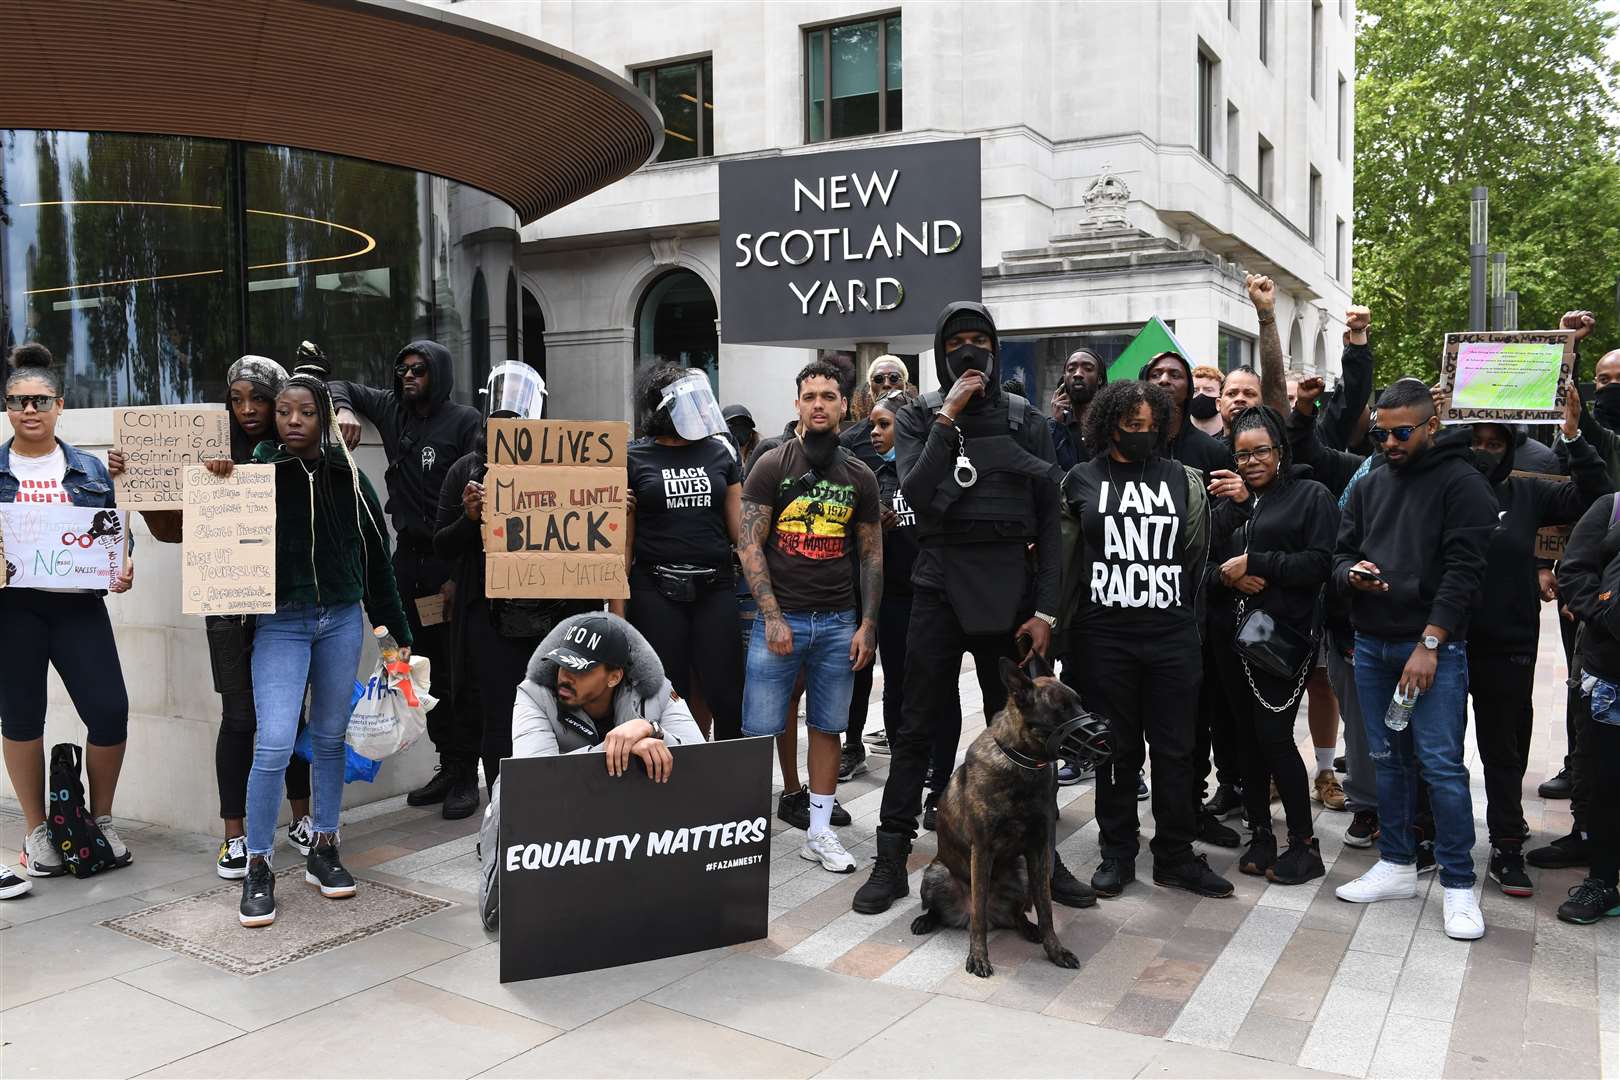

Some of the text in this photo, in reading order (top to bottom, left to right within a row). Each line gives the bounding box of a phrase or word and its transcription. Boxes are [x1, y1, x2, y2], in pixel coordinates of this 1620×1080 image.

[794, 169, 899, 212] NEW
[735, 220, 962, 268] SCOTLAND
[788, 277, 905, 315] YARD
[123, 411, 206, 436] Coming
[1448, 408, 1494, 420] BLACK
[1524, 411, 1566, 420] MATTER
[119, 429, 181, 452] together
[494, 427, 533, 464] NO
[661, 466, 708, 480] BLACK
[667, 478, 709, 496] LIVES
[569, 486, 624, 507] UNTIL
[666, 495, 712, 510] MATTER
[1098, 481, 1177, 515] I AM
[506, 511, 613, 552] BLACK
[1103, 515, 1180, 561] ANTI
[491, 560, 622, 590] LIVES MATTER
[1090, 561, 1183, 609] RACIST
[563, 625, 602, 650] ICON
[506, 817, 767, 872] EQUALITY MATTERS
[705, 854, 763, 872] #FAZAMNESTY
